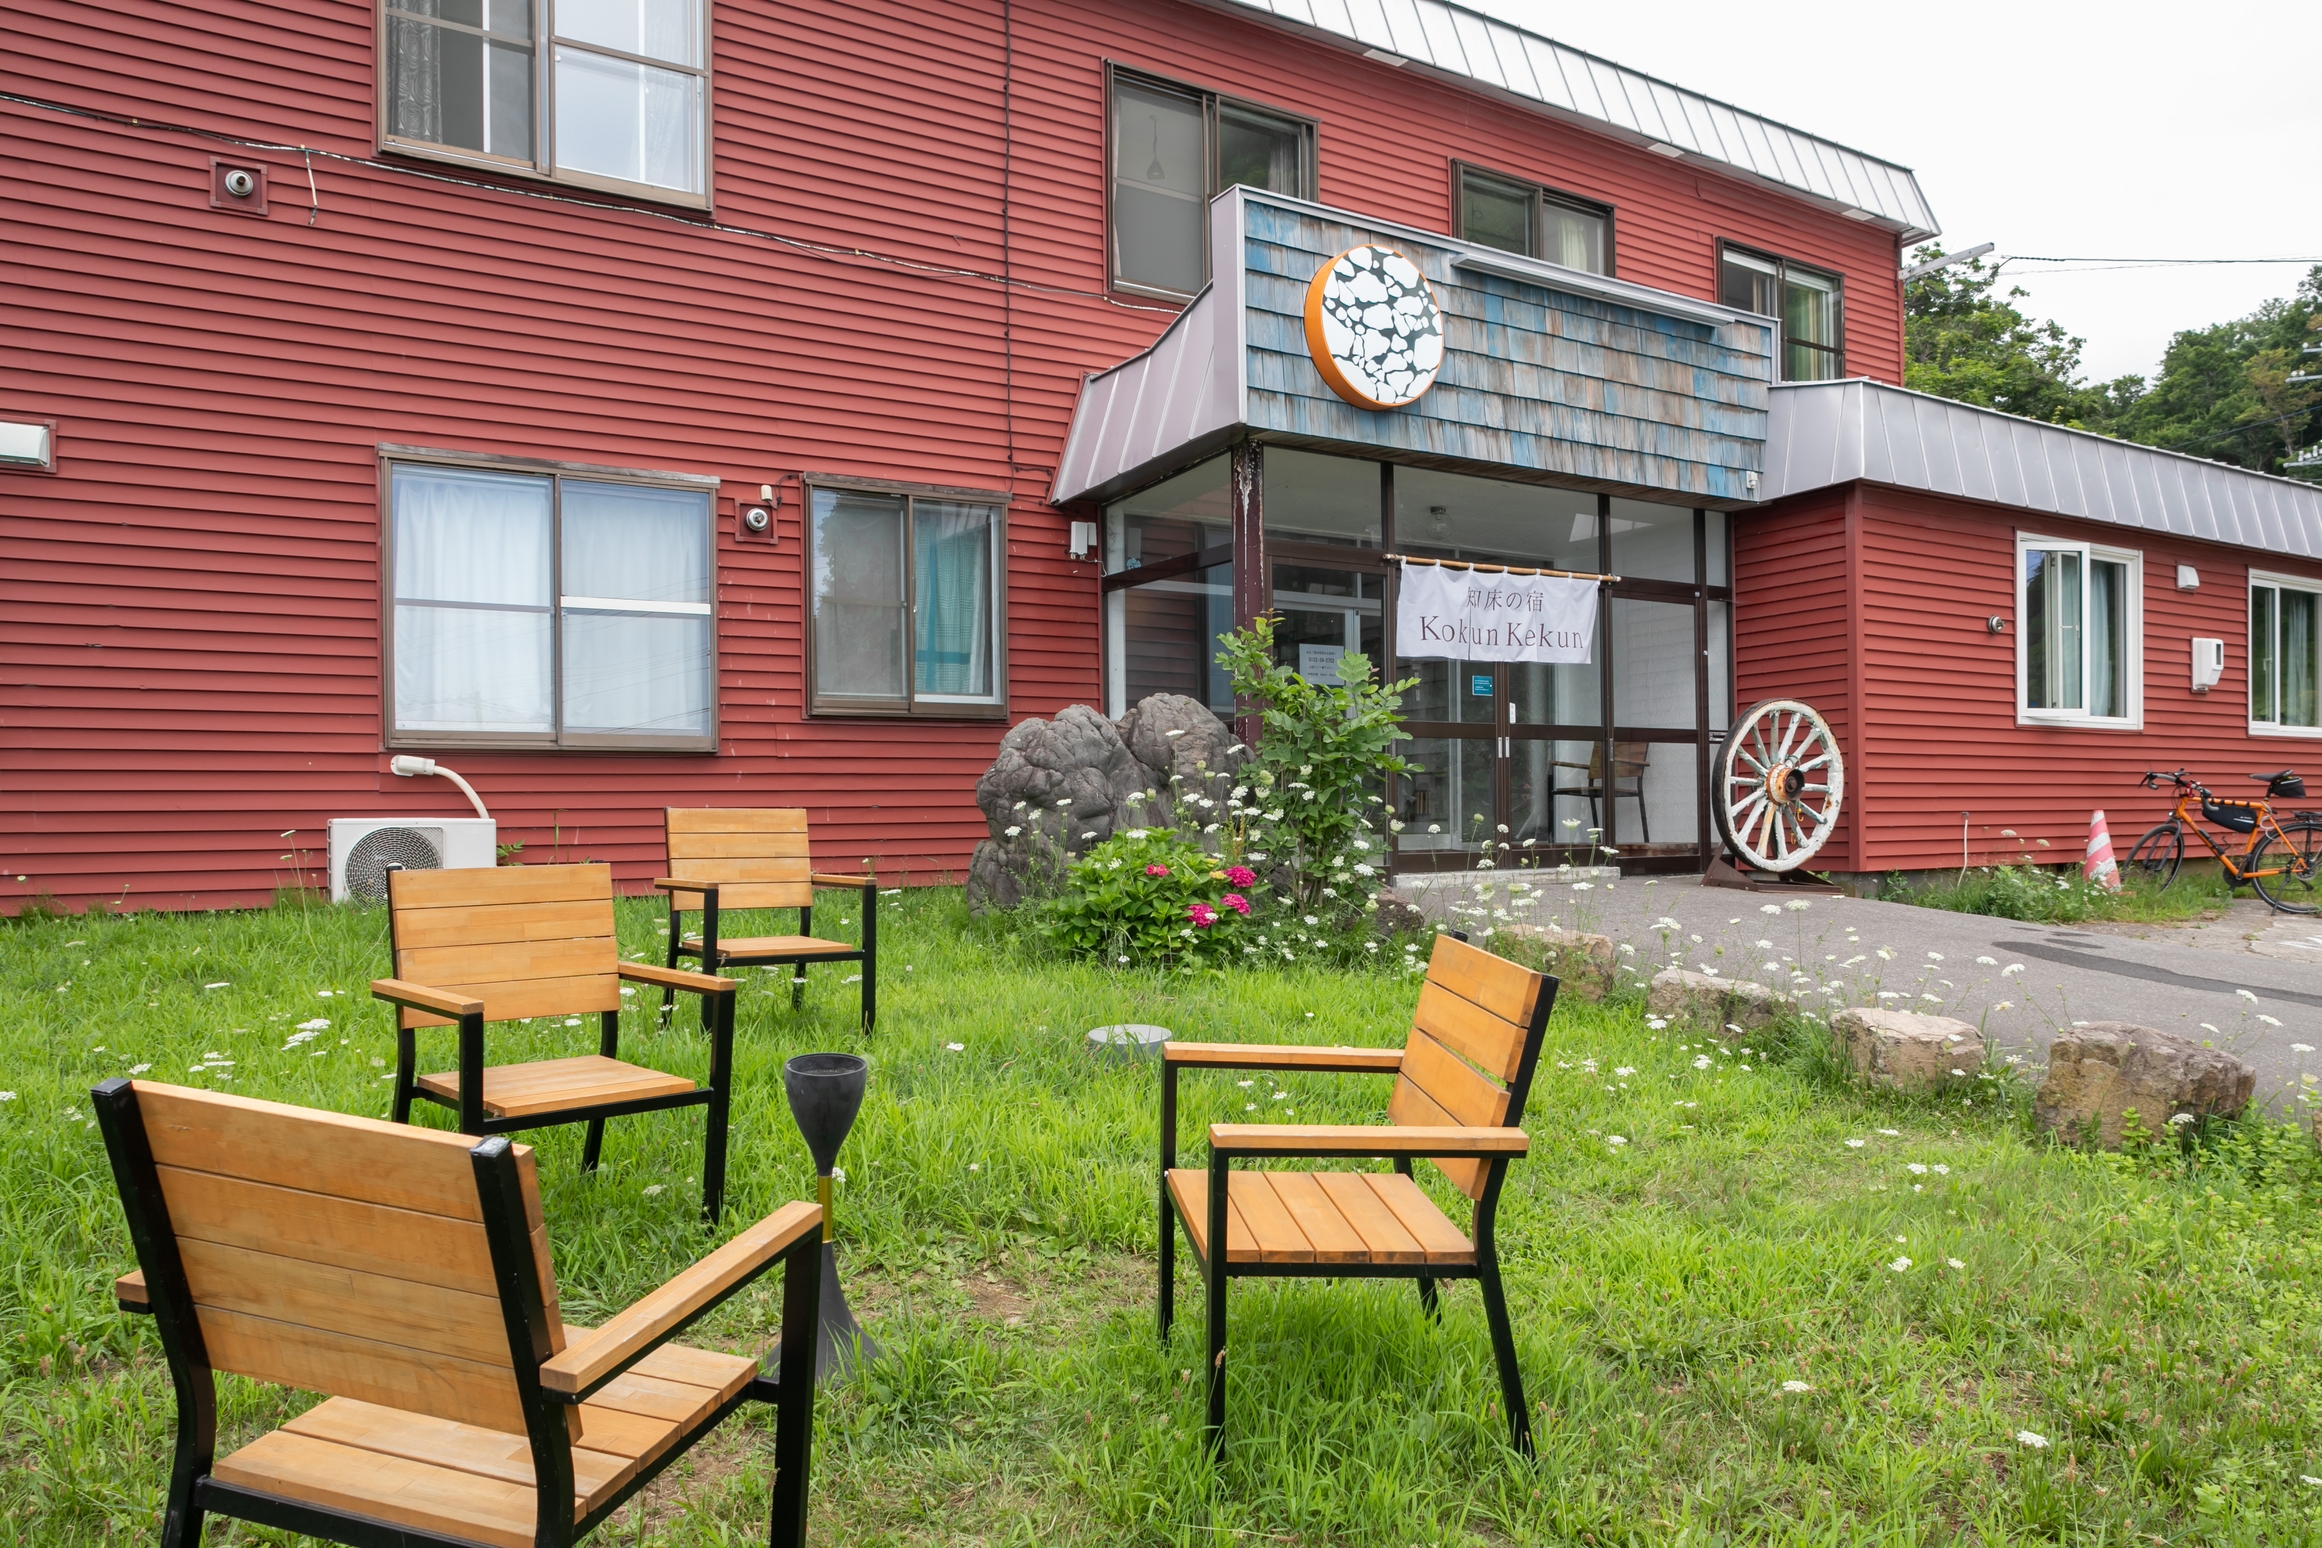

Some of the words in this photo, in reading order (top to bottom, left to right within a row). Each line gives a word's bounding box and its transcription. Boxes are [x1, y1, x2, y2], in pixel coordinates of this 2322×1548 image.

[1466, 586, 1544, 613] 知床の宿
[1420, 615, 1499, 647] Kokun
[1506, 622, 1584, 649] Kekun
